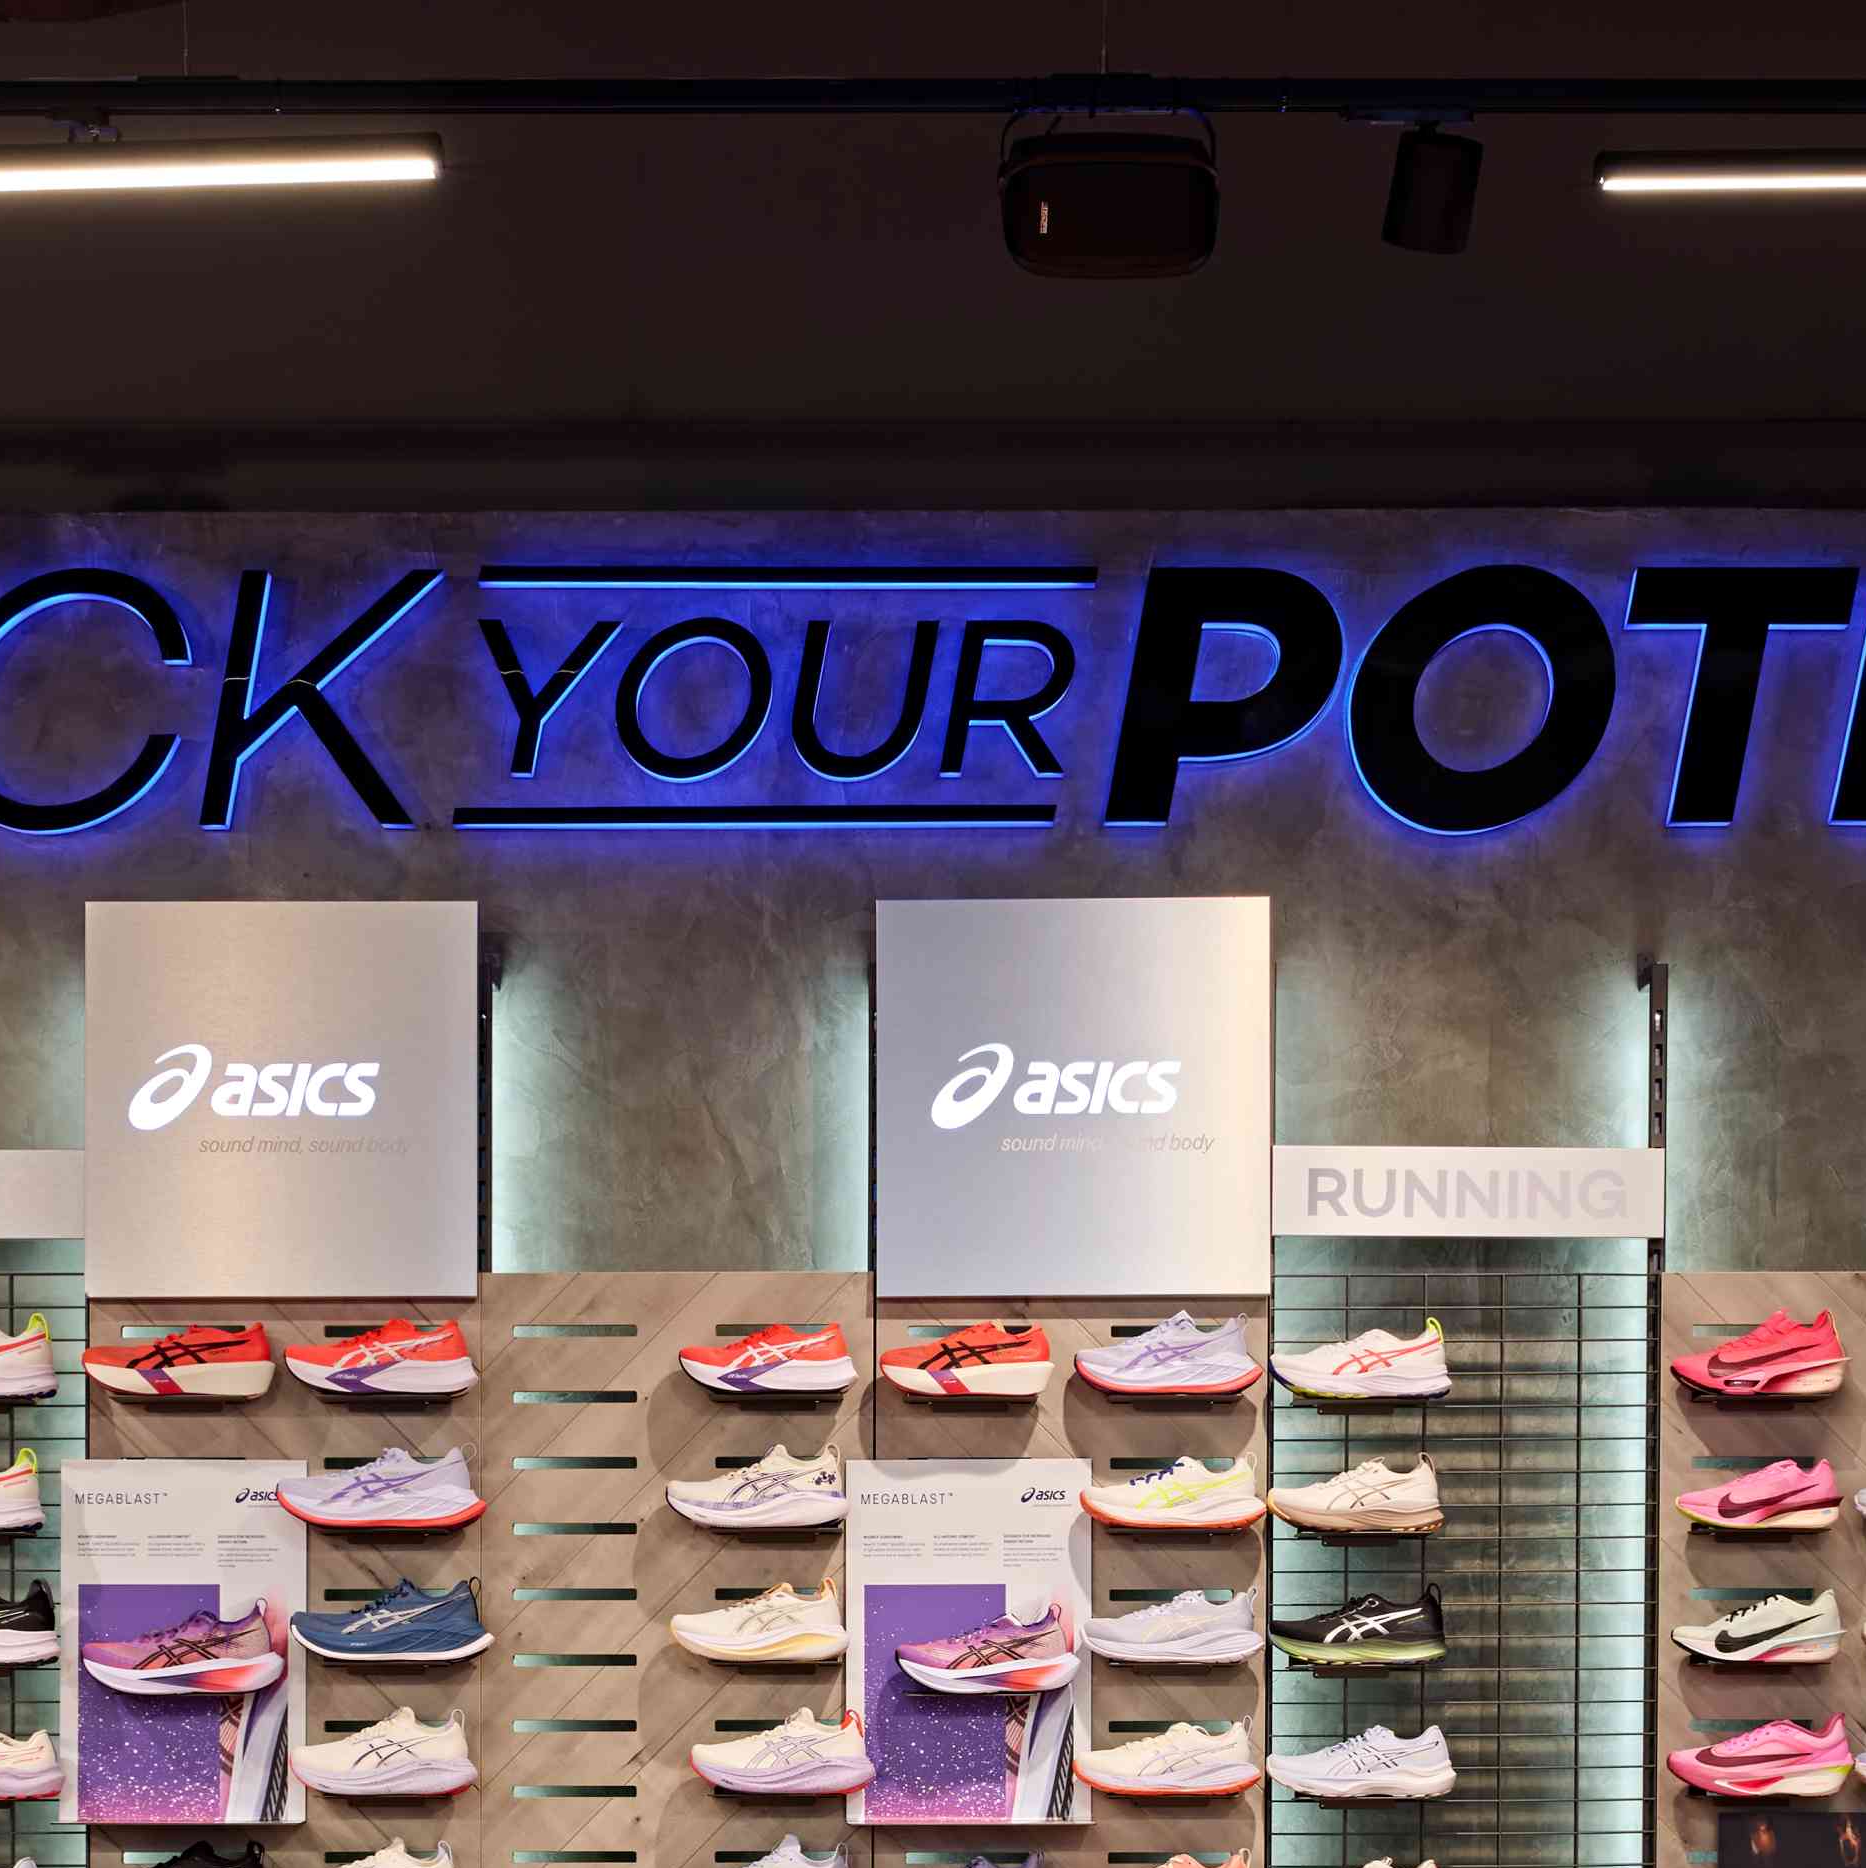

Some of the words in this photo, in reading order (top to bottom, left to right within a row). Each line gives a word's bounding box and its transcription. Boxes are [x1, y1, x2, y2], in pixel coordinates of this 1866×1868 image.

[477, 617, 1077, 786] YOUR
[198, 1136, 254, 1152] sound
[1000, 1134, 1056, 1152] sound
[1307, 1167, 1628, 1218] RUNNING
